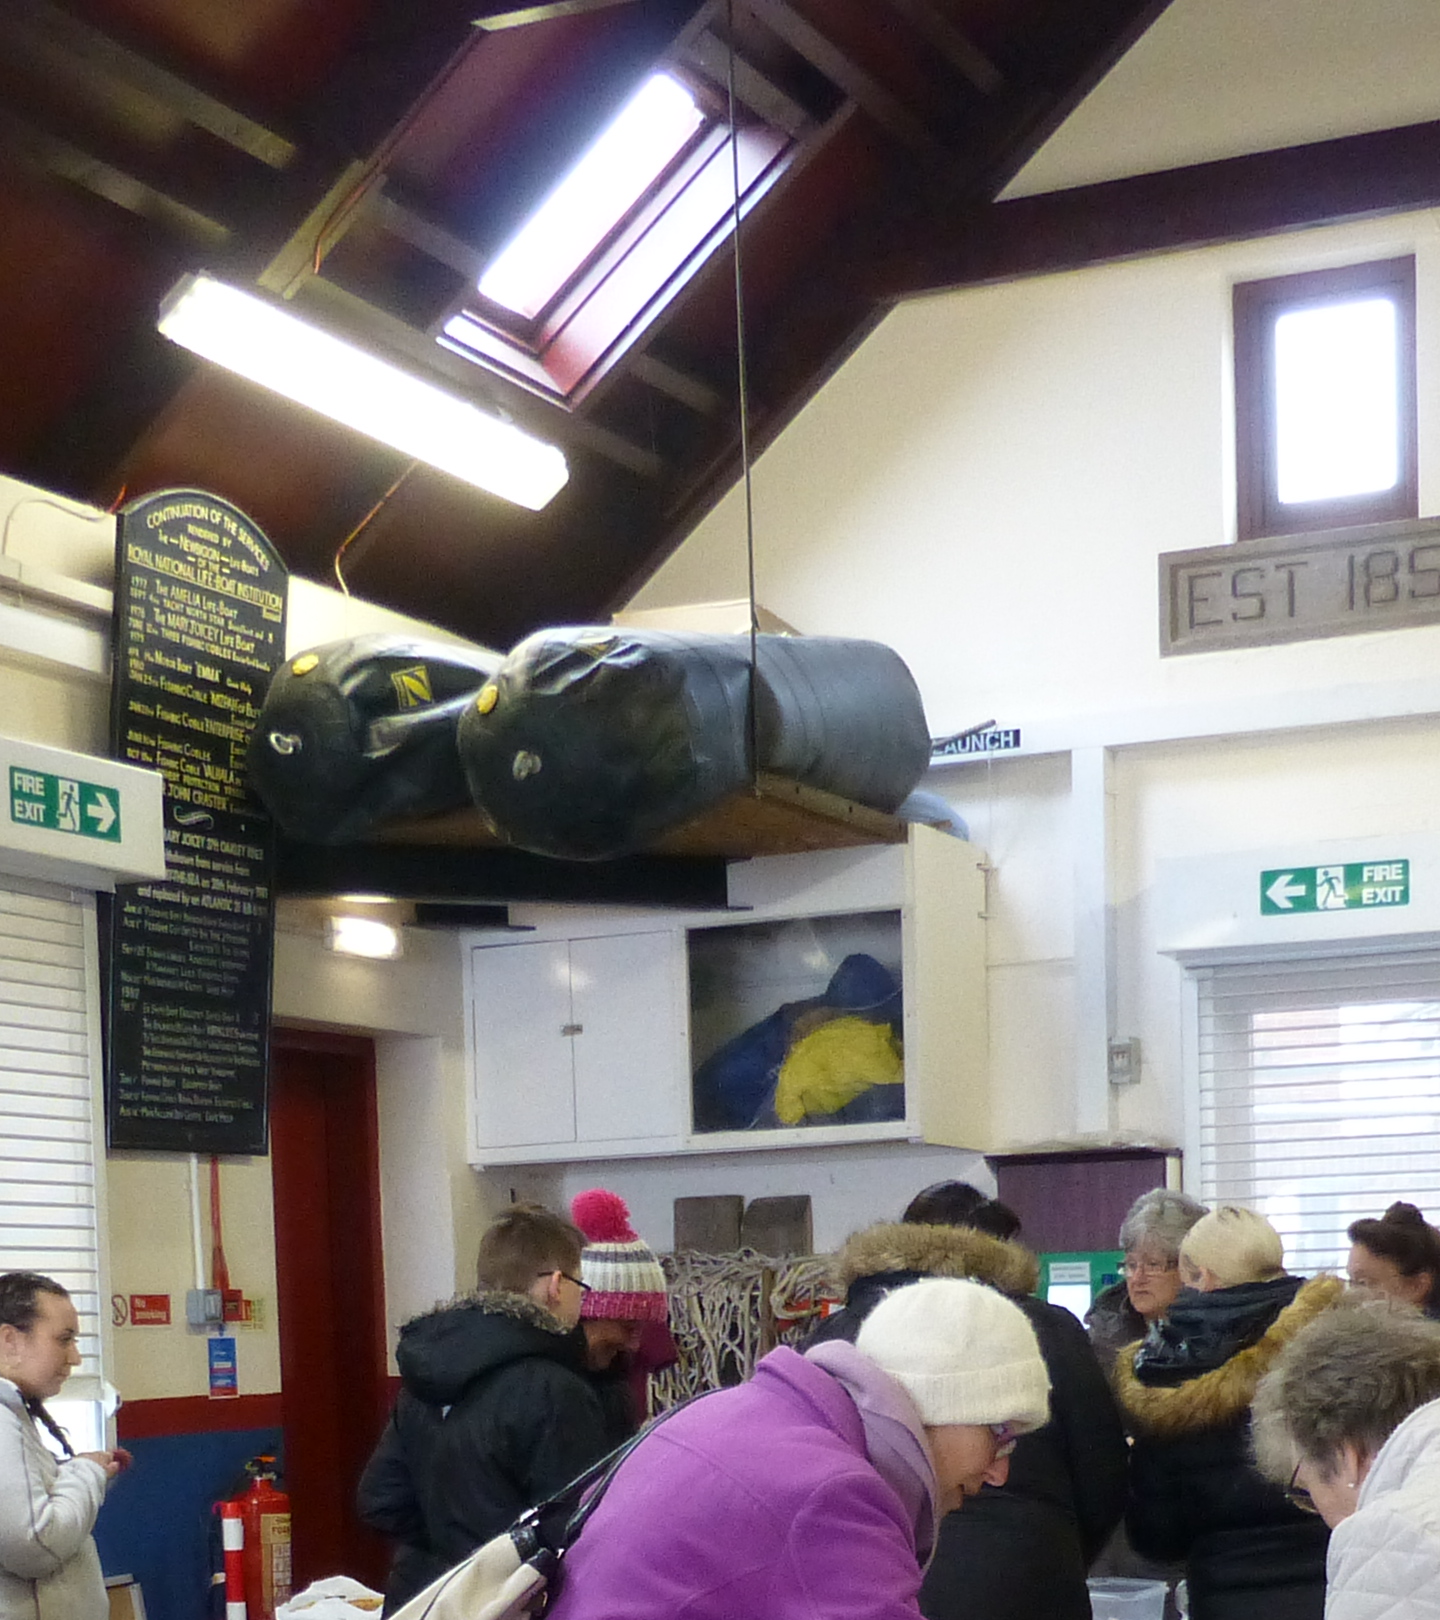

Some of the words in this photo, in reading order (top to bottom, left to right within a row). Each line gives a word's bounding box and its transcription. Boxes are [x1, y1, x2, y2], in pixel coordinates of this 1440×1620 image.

[146, 502, 209, 529] CONTINUATION
[1187, 561, 1308, 629] EST
[13, 771, 45, 796] FIRE
[14, 800, 46, 823] EXIT
[1363, 863, 1403, 882] FIRE
[1362, 886, 1405, 904] EXIT
